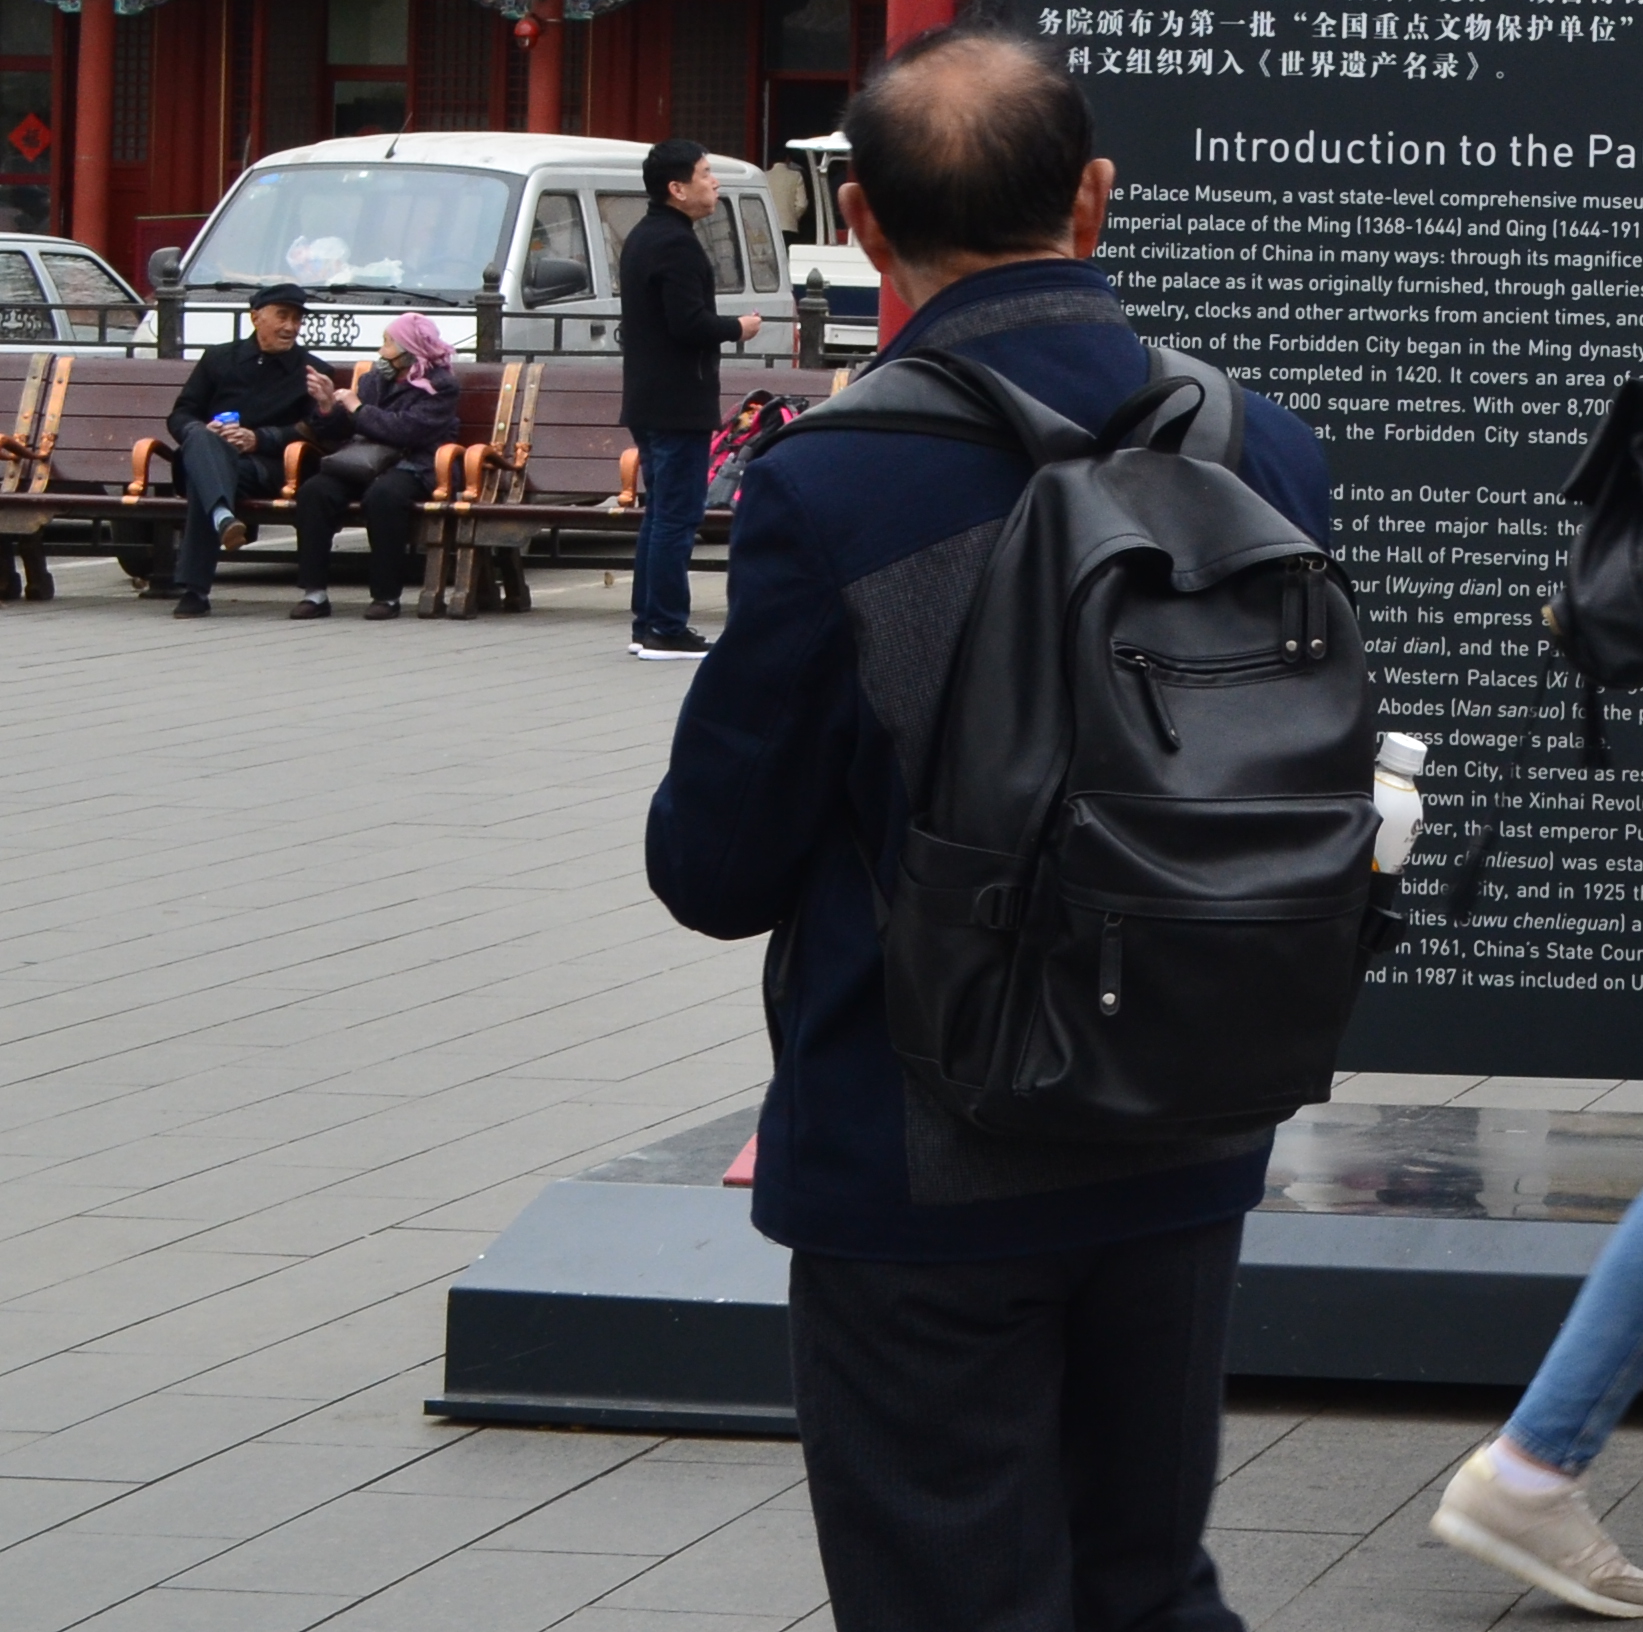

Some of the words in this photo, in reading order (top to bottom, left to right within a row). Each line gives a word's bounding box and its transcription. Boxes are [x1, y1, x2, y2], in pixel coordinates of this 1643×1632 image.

[1195, 127, 1446, 166] Introduction
[1459, 134, 1497, 167] to
[1509, 132, 1574, 168] the
[1129, 183, 1190, 202] Palace
[1195, 184, 1277, 206] Museum,
[1282, 190, 1293, 204] a
[1297, 187, 1334, 205] vast
[1339, 187, 1435, 206] state-level
[1439, 189, 1577, 213] comprehensive
[1107, 211, 1183, 235] imperial
[1187, 213, 1246, 236] palace
[1251, 214, 1269, 233] of
[1273, 215, 1302, 233] the
[1307, 215, 1351, 239] Ming
[1356, 215, 1462, 237] (1368-1644)
[1467, 219, 1501, 237] and
[1506, 218, 1547, 243] Qing
[1140, 242, 1235, 261] civilization
[1239, 243, 1258, 261] of
[1262, 243, 1314, 262] China
[1319, 244, 1335, 262] in
[1340, 250, 1391, 268] many
[1393, 250, 1445, 265] ways:
[1450, 247, 1521, 270] through
[1527, 248, 1549, 267] its
[1209, 332, 1227, 350] of
[1233, 333, 1262, 351] the
[1269, 333, 1359, 353] Forbidden
[1366, 335, 1401, 358] City
[1407, 336, 1462, 359] began
[1469, 338, 1485, 355] in
[1492, 338, 1521, 356] the
[1528, 338, 1572, 362] Ming
[1225, 365, 1262, 381] was
[1269, 362, 1363, 387] completed
[1370, 365, 1387, 382] in
[1396, 364, 1442, 384] 1420.
[1450, 366, 1462, 384] It
[1469, 370, 1529, 385] covers
[1535, 372, 1558, 386] an
[1565, 373, 1606, 387] area
[1351, 483, 1385, 502] into
[1390, 488, 1413, 502] an
[1419, 485, 1471, 503] Outer
[1476, 486, 1527, 504] Court
[1351, 544, 1381, 563] the
[1386, 545, 1423, 563] Hall
[1428, 546, 1446, 564] of
[1451, 546, 1549, 572] Preserving
[1471, 789, 1487, 808] in
[1494, 792, 1523, 808] the
[1529, 792, 1585, 811] Xinhai
[1479, 882, 1509, 902] ity,
[1516, 880, 1550, 899] and
[1558, 881, 1574, 900] in
[1584, 882, 1625, 901] 1925
[1420, 937, 1466, 959] 1961,
[1473, 939, 1540, 959] China's
[1546, 941, 1594, 960] State
[1392, 966, 1408, 984] in
[1415, 967, 1457, 986] 1987
[1462, 968, 1473, 986] it
[1478, 973, 1515, 987] was
[1520, 971, 1598, 990] included
[1603, 977, 1625, 991] on
